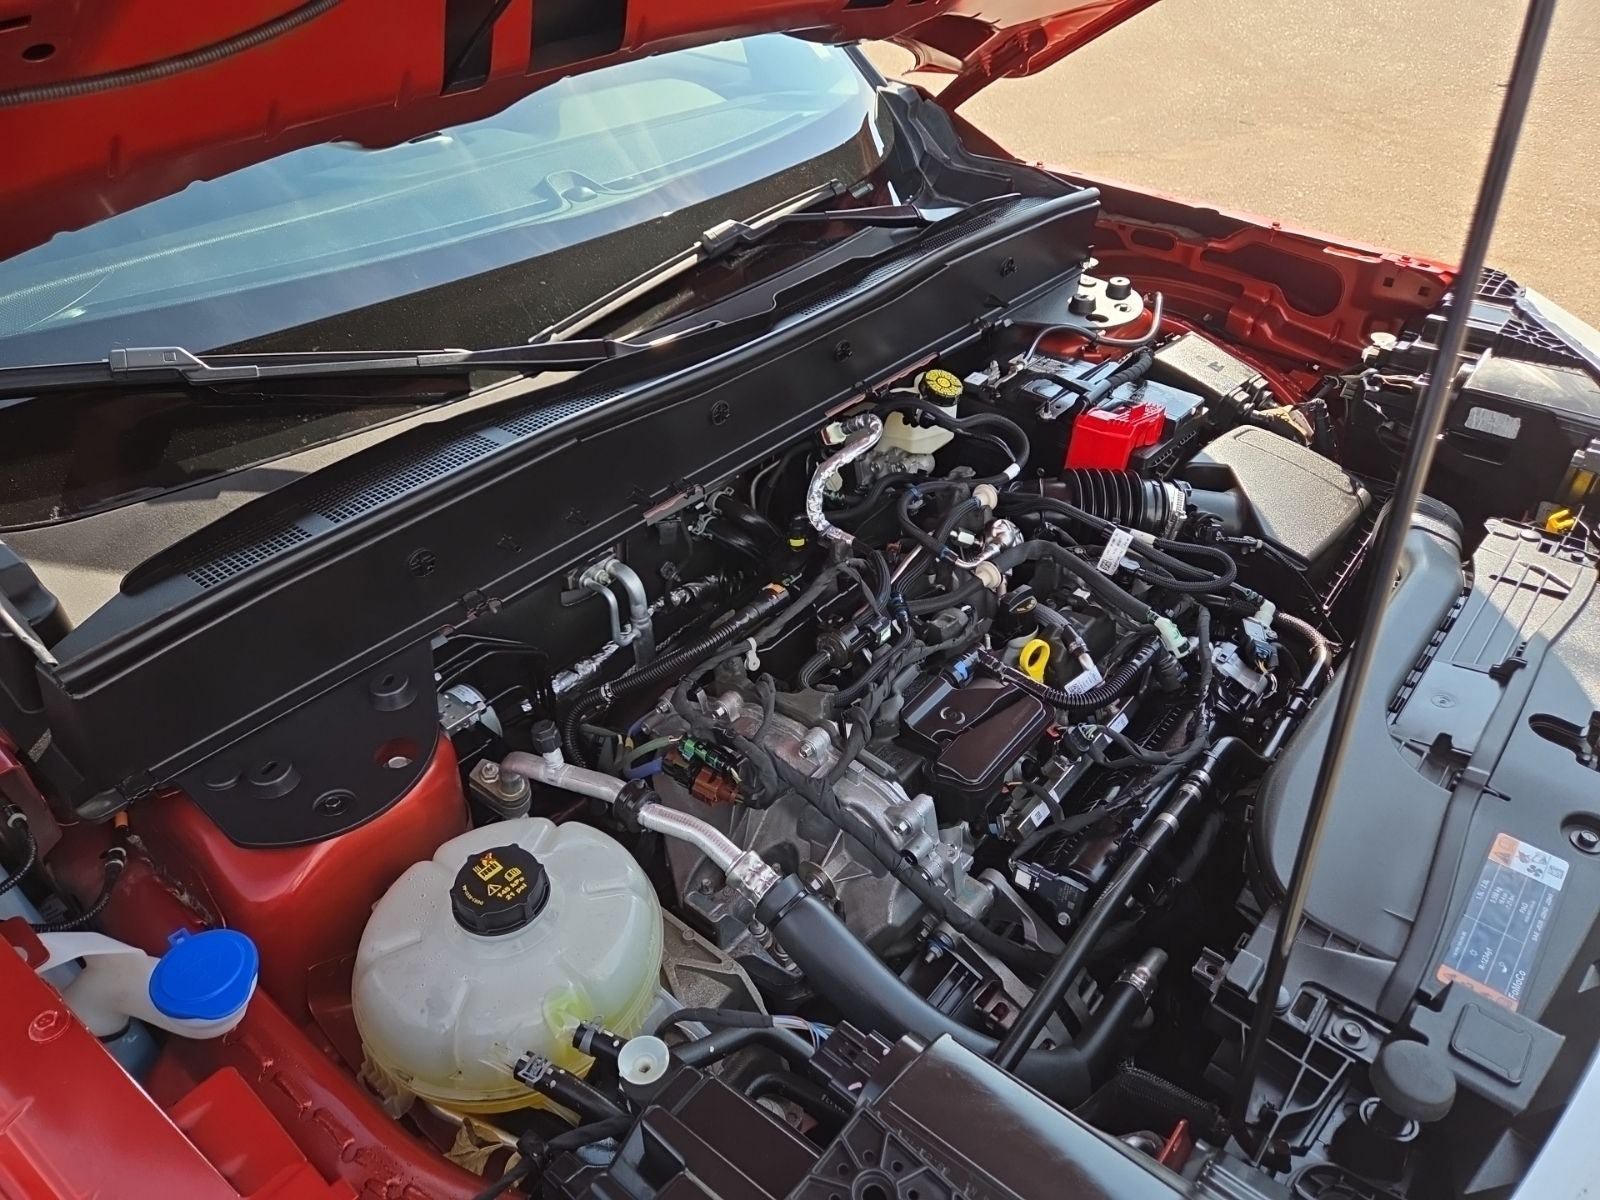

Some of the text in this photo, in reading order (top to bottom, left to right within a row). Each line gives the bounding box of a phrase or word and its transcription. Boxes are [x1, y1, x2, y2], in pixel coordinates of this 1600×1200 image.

[496, 886, 510, 898] 145
[511, 876, 525, 888] kPa
[505, 883, 527, 901] 21 psi
